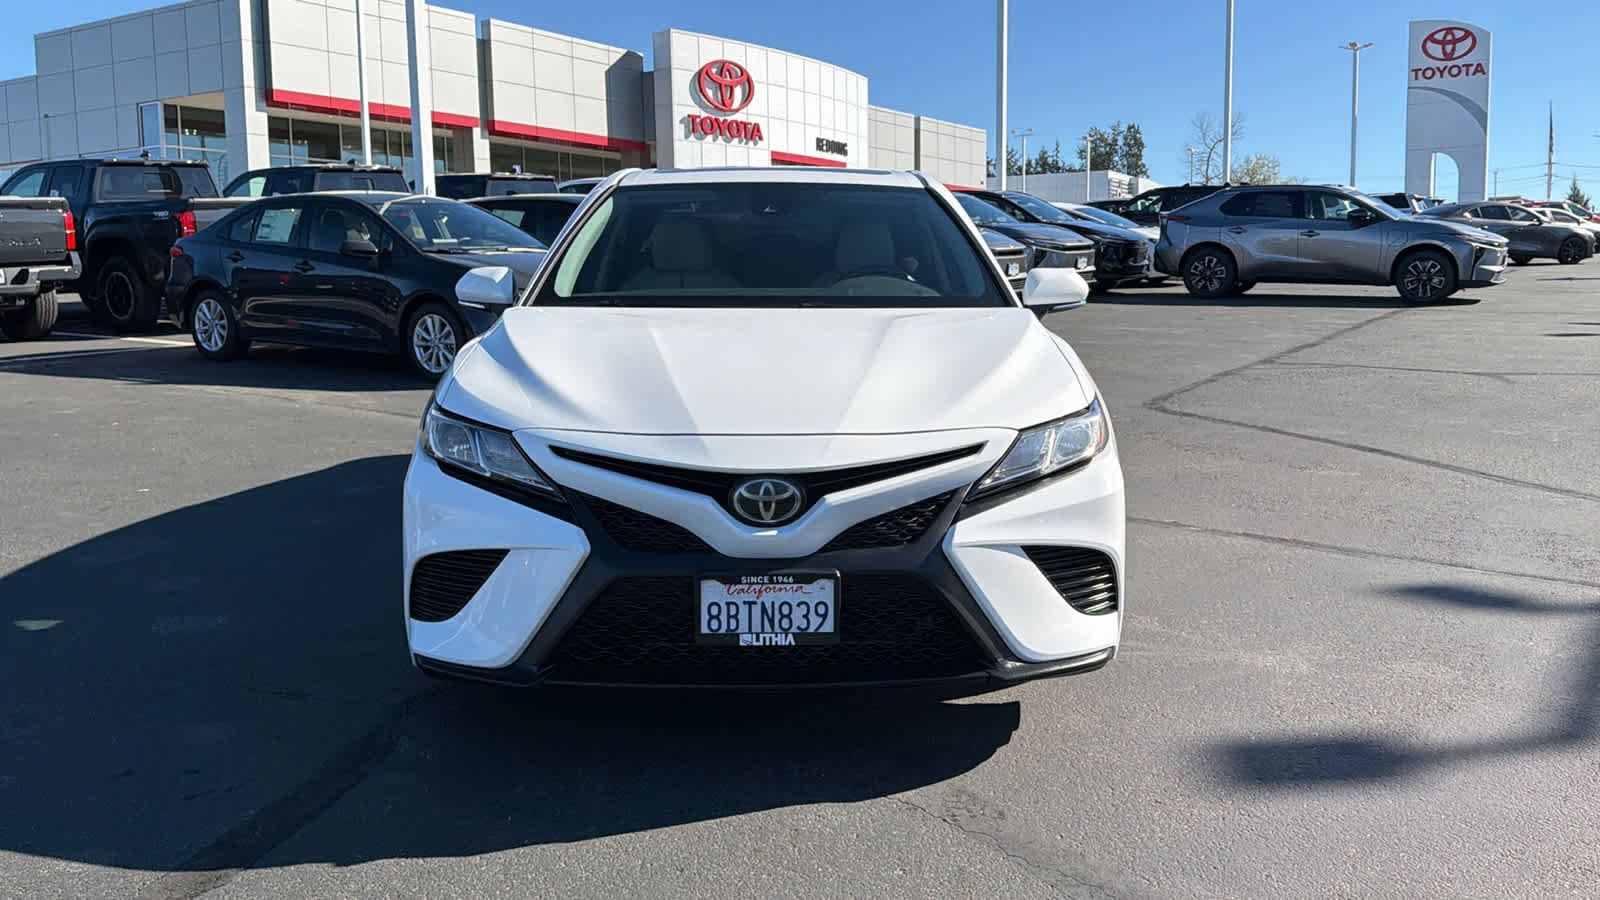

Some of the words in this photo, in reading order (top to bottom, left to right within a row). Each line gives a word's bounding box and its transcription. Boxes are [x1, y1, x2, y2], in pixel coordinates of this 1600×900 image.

[1411, 63, 1486, 80] TOYOTA
[687, 114, 764, 141] TOYOTA
[727, 584, 812, 599] California
[707, 601, 829, 632] 8BTN839
[752, 634, 796, 646] LITHIA
